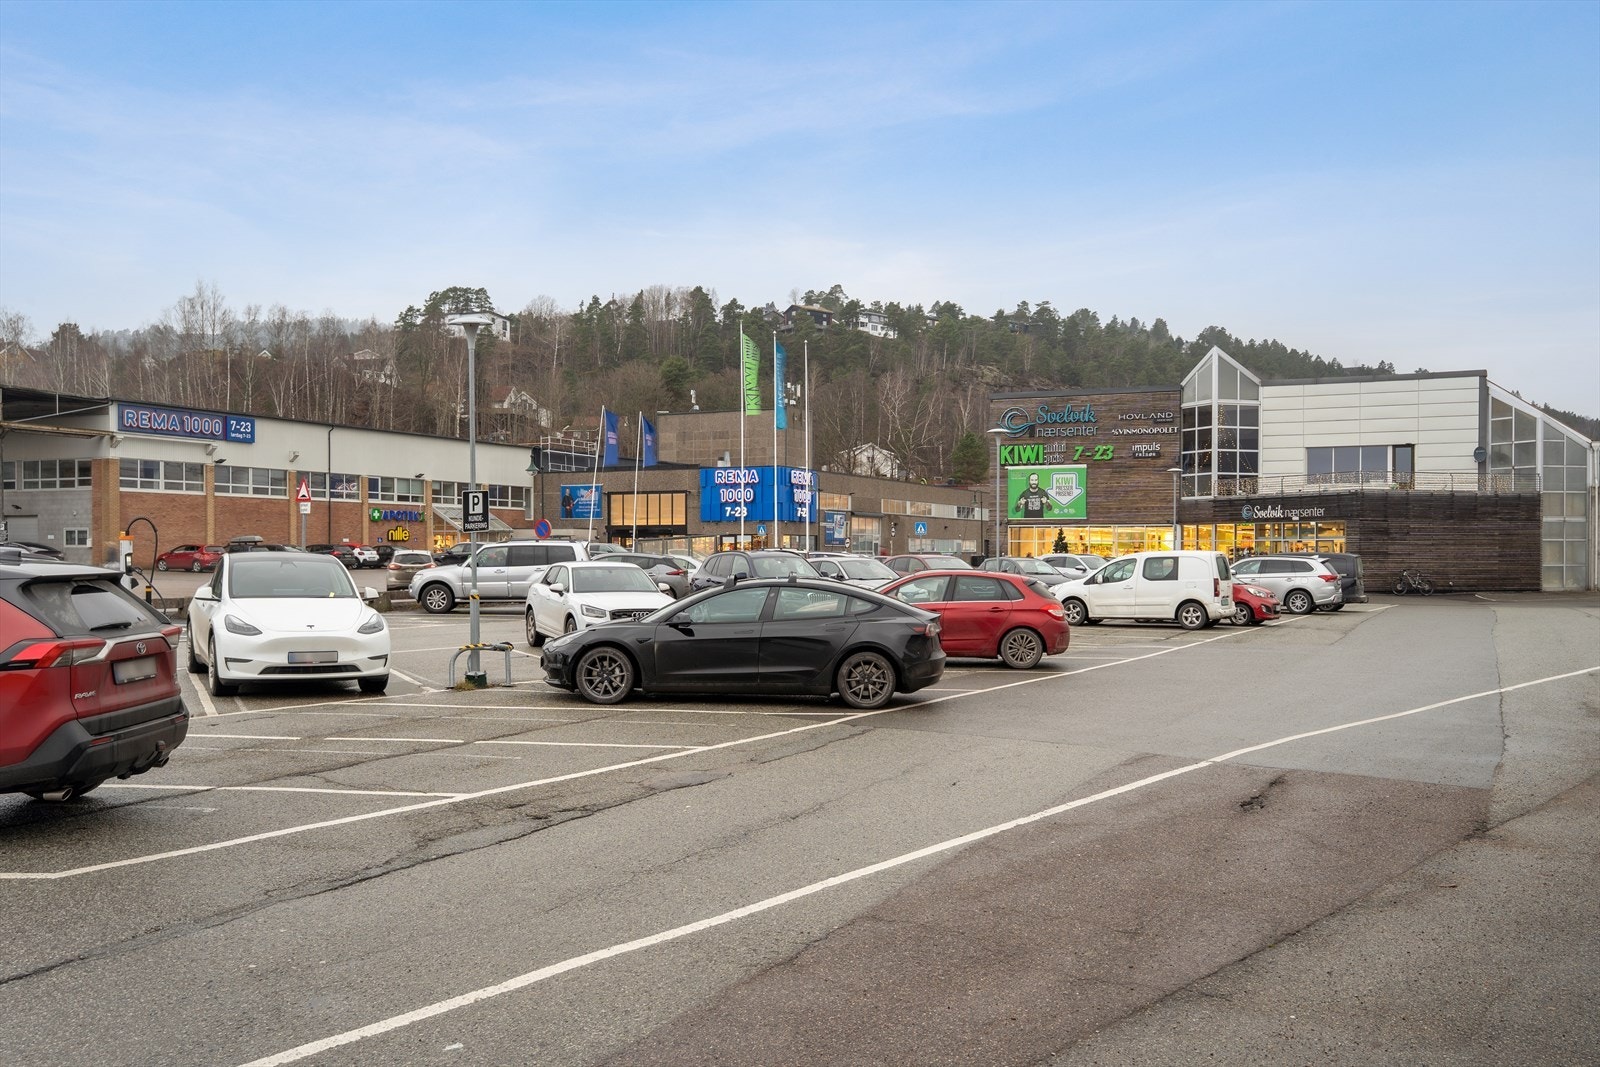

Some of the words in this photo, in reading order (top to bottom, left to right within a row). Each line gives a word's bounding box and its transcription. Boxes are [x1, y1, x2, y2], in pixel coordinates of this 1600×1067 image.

[745, 361, 760, 410] KIWI
[1036, 403, 1098, 424] Svelvik
[1118, 411, 1174, 420] HOVLAND
[124, 409, 180, 432] REMA
[184, 415, 222, 435] 1000
[230, 420, 252, 432] 7-23
[1036, 424, 1098, 438] nærsenter
[1119, 426, 1179, 435] VINMONOPOLET
[1000, 444, 1044, 465] KIWI
[1132, 441, 1161, 456] impuls
[715, 469, 759, 484] REMA
[1056, 476, 1074, 486] KIWI
[472, 494, 480, 511] P
[720, 488, 755, 502] 1000
[382, 510, 419, 521] APOTEK
[1253, 504, 1284, 519] Svelvik
[1285, 506, 1326, 518] nærsenter
[464, 521, 488, 530] PARKERING
[387, 525, 410, 542] nille
